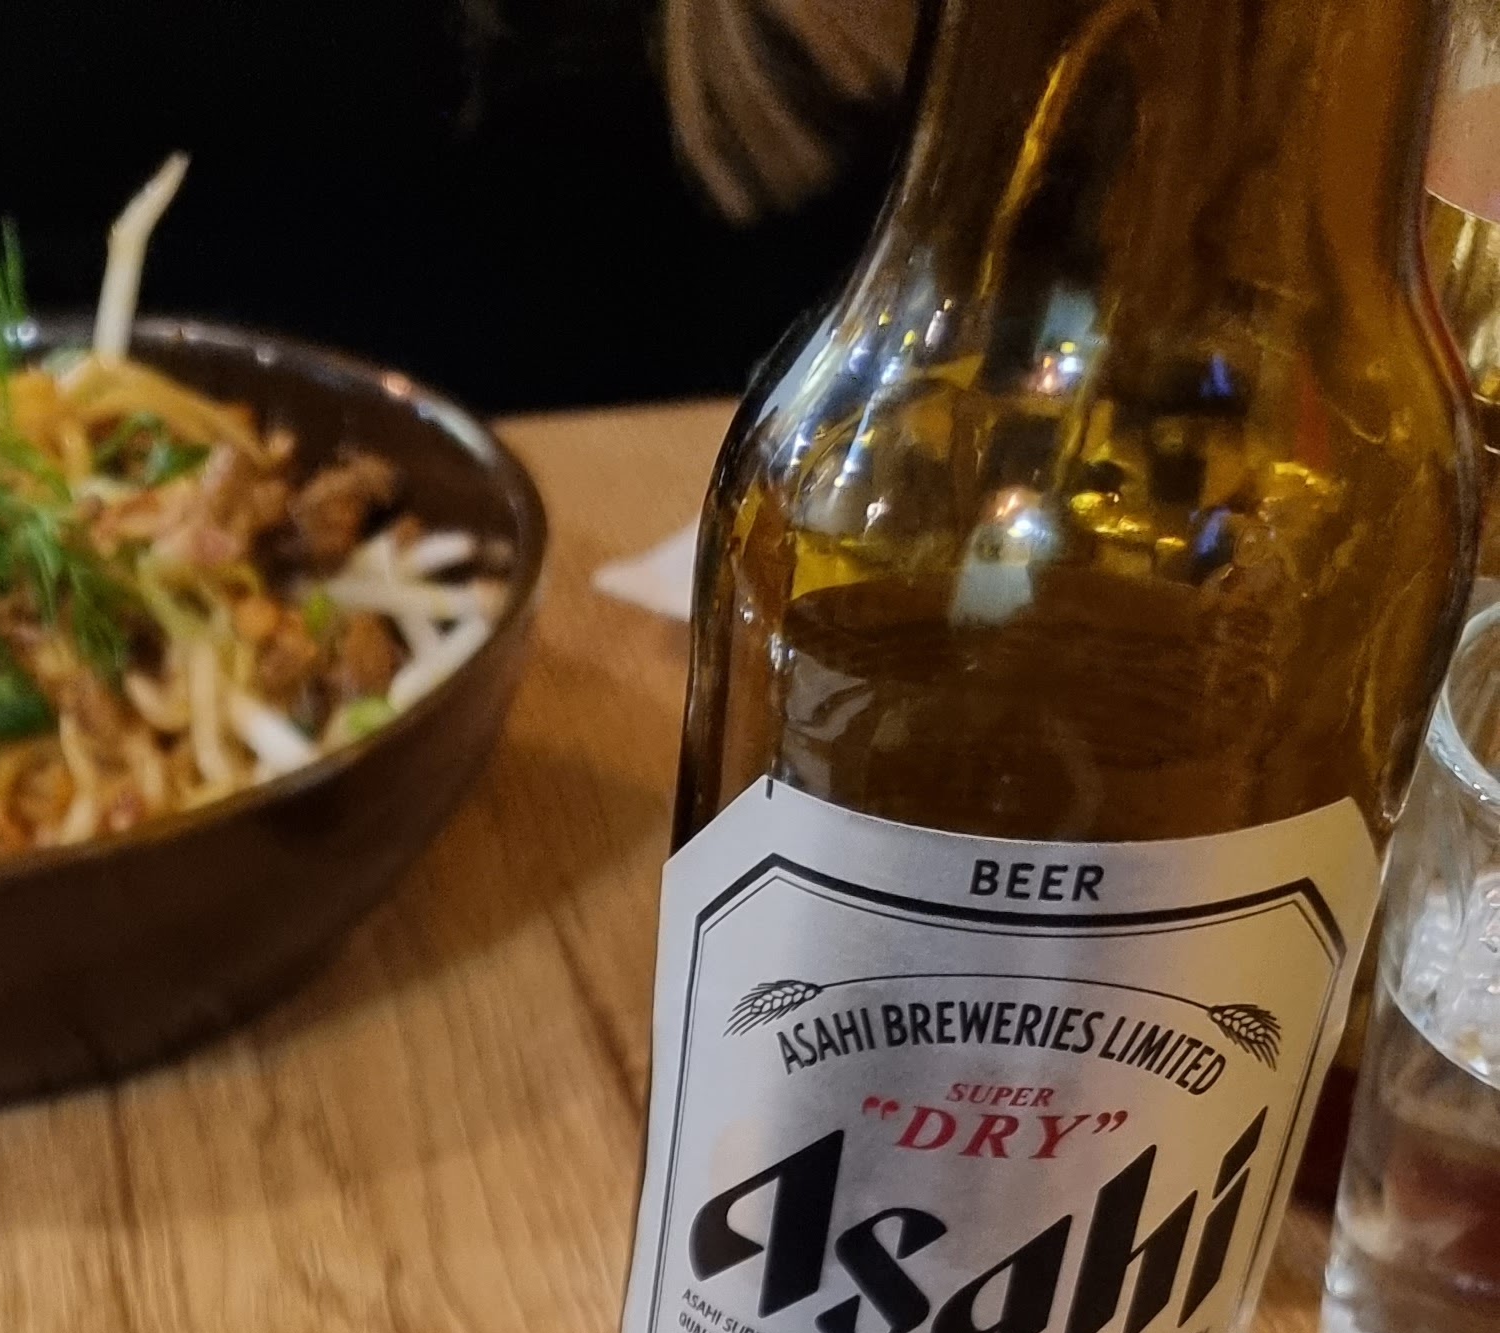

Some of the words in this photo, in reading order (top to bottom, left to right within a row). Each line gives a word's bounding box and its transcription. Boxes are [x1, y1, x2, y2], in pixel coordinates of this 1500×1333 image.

[969, 859, 1106, 903] BEER
[777, 1007, 876, 1075] ASAHI
[881, 1001, 1104, 1054] BREWERIES
[1098, 1016, 1226, 1095] LIMITED
[947, 1083, 1055, 1107] SUPER
[682, 1288, 722, 1325] ASAHI
